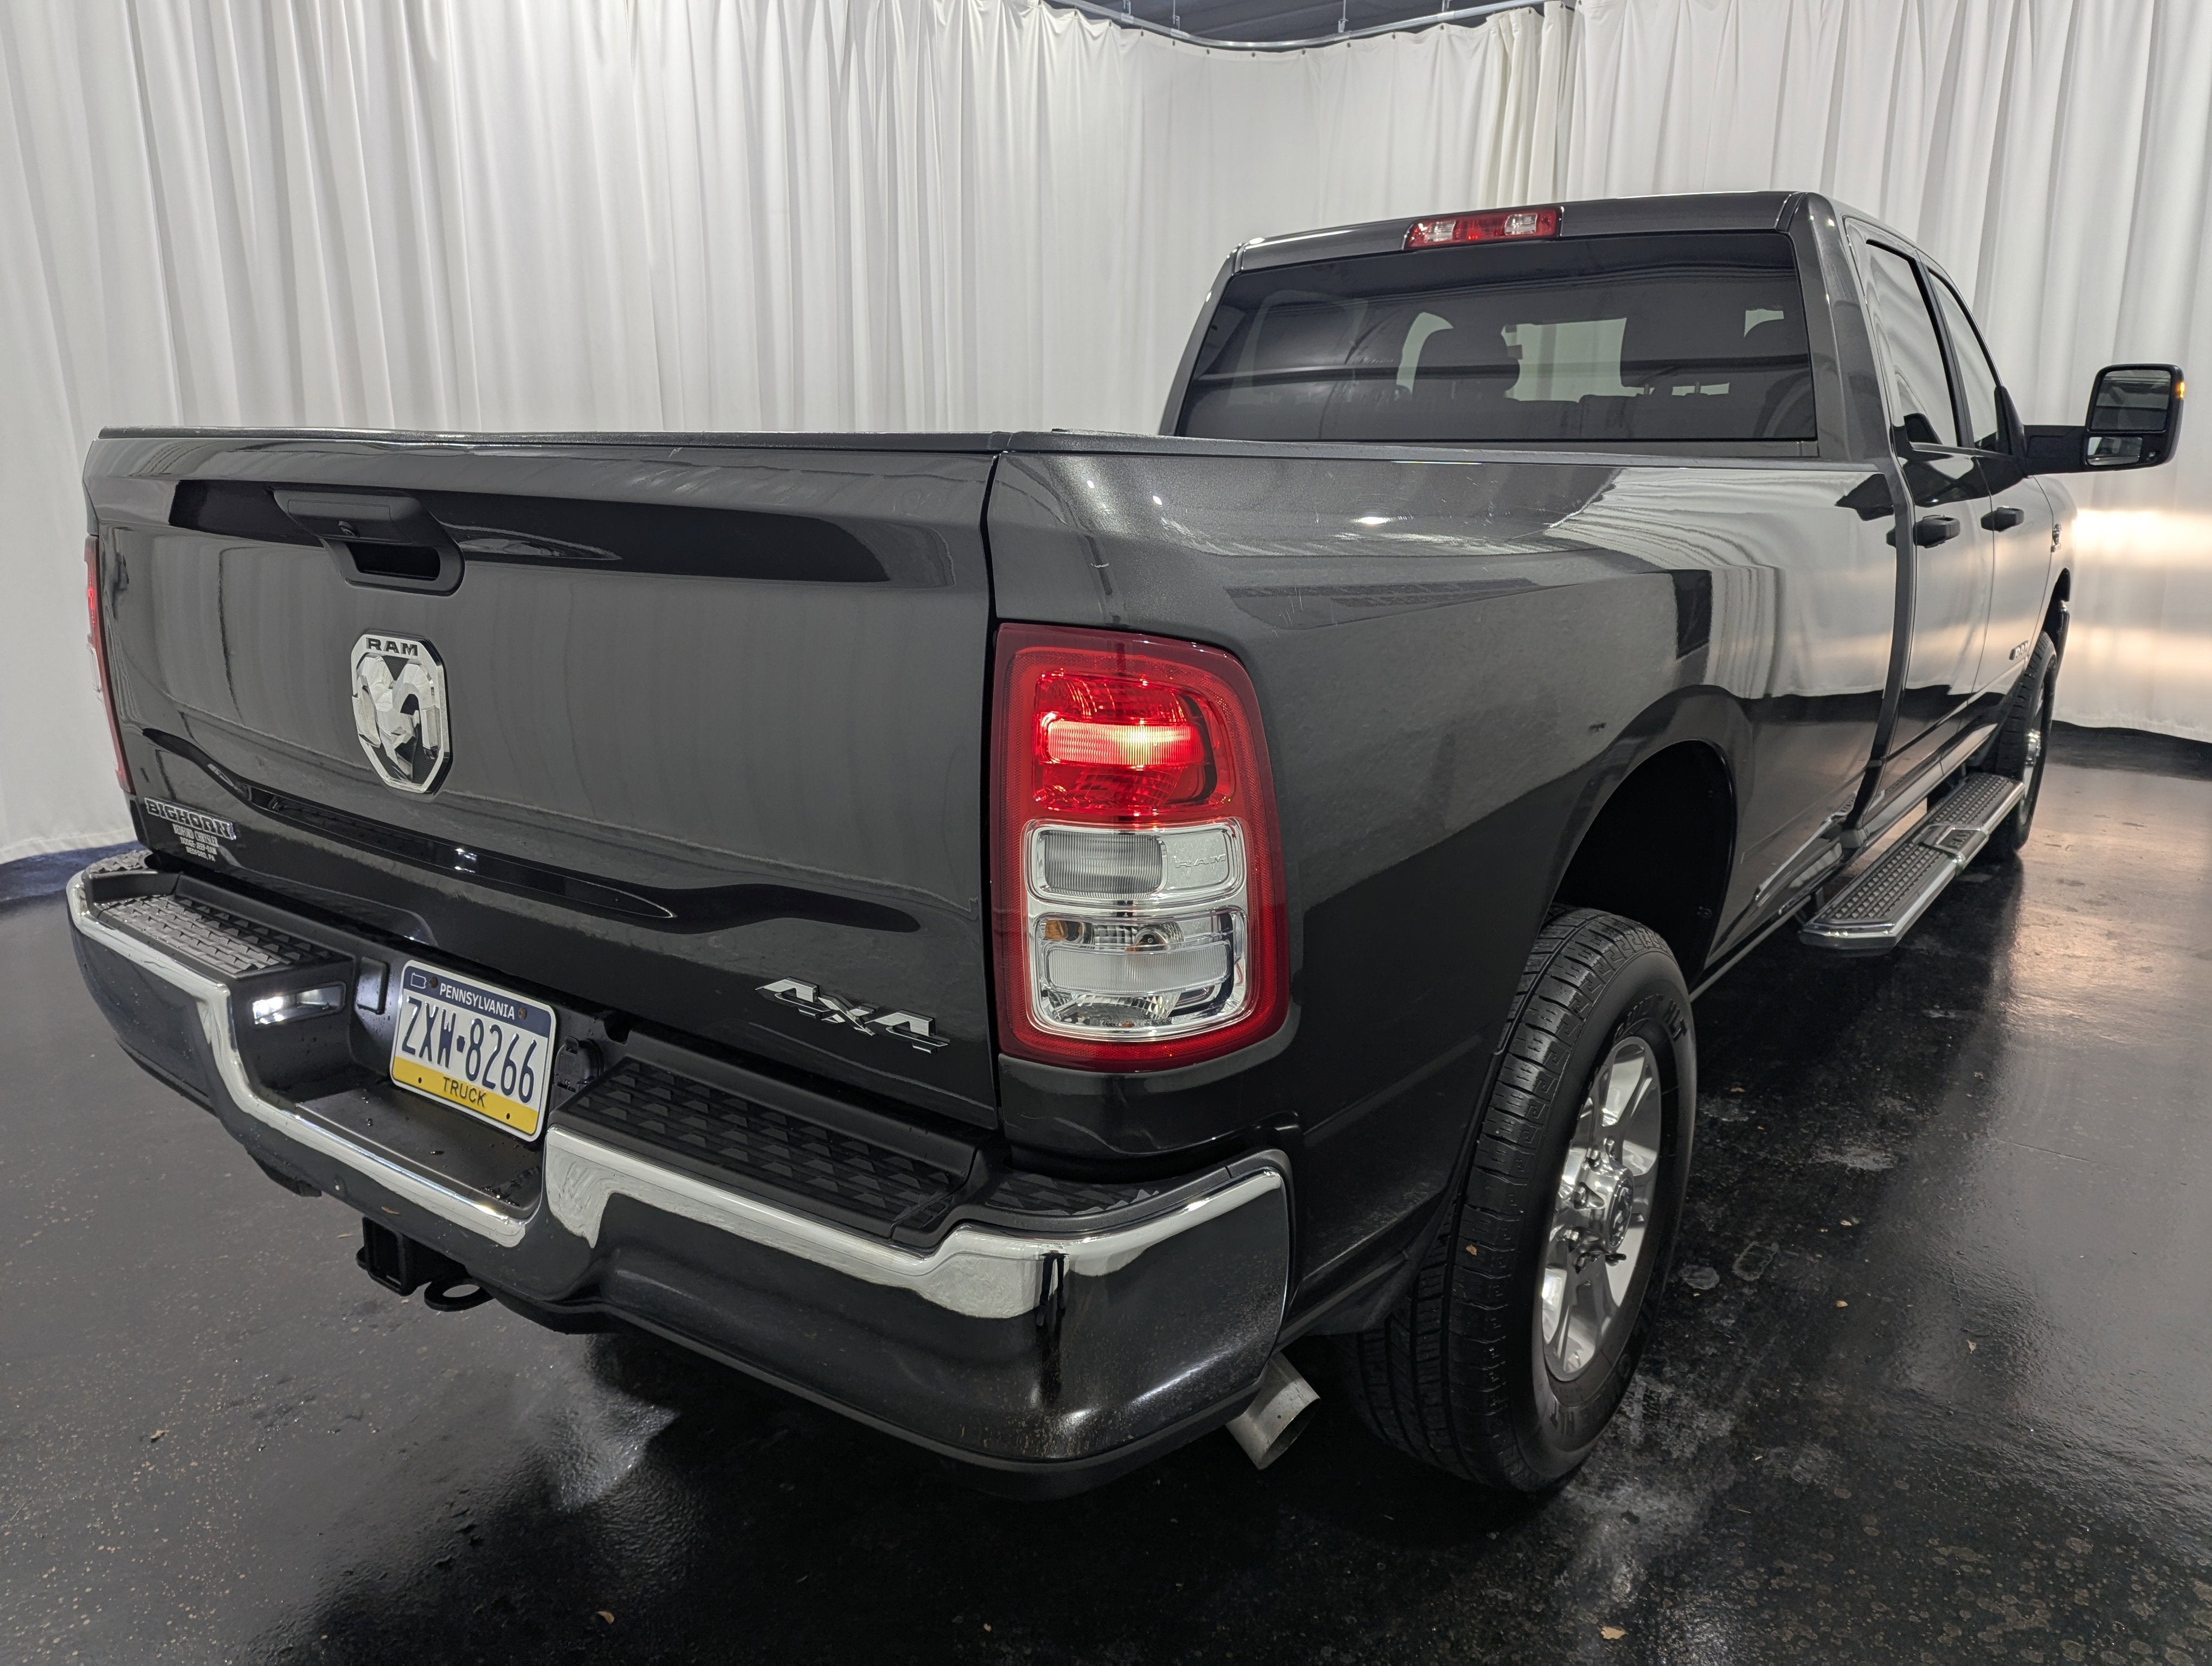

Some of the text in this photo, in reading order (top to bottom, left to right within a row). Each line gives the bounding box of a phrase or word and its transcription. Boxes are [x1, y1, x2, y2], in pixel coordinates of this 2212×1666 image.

[366, 638, 418, 656] RAM
[144, 798, 236, 840] BIGHORN
[172, 823, 219, 847] BEDFORD CHRYSLER
[1174, 854, 1226, 868] RAM
[439, 983, 515, 1020] PENNSYLVANIA
[443, 1077, 487, 1108] TRUCK
